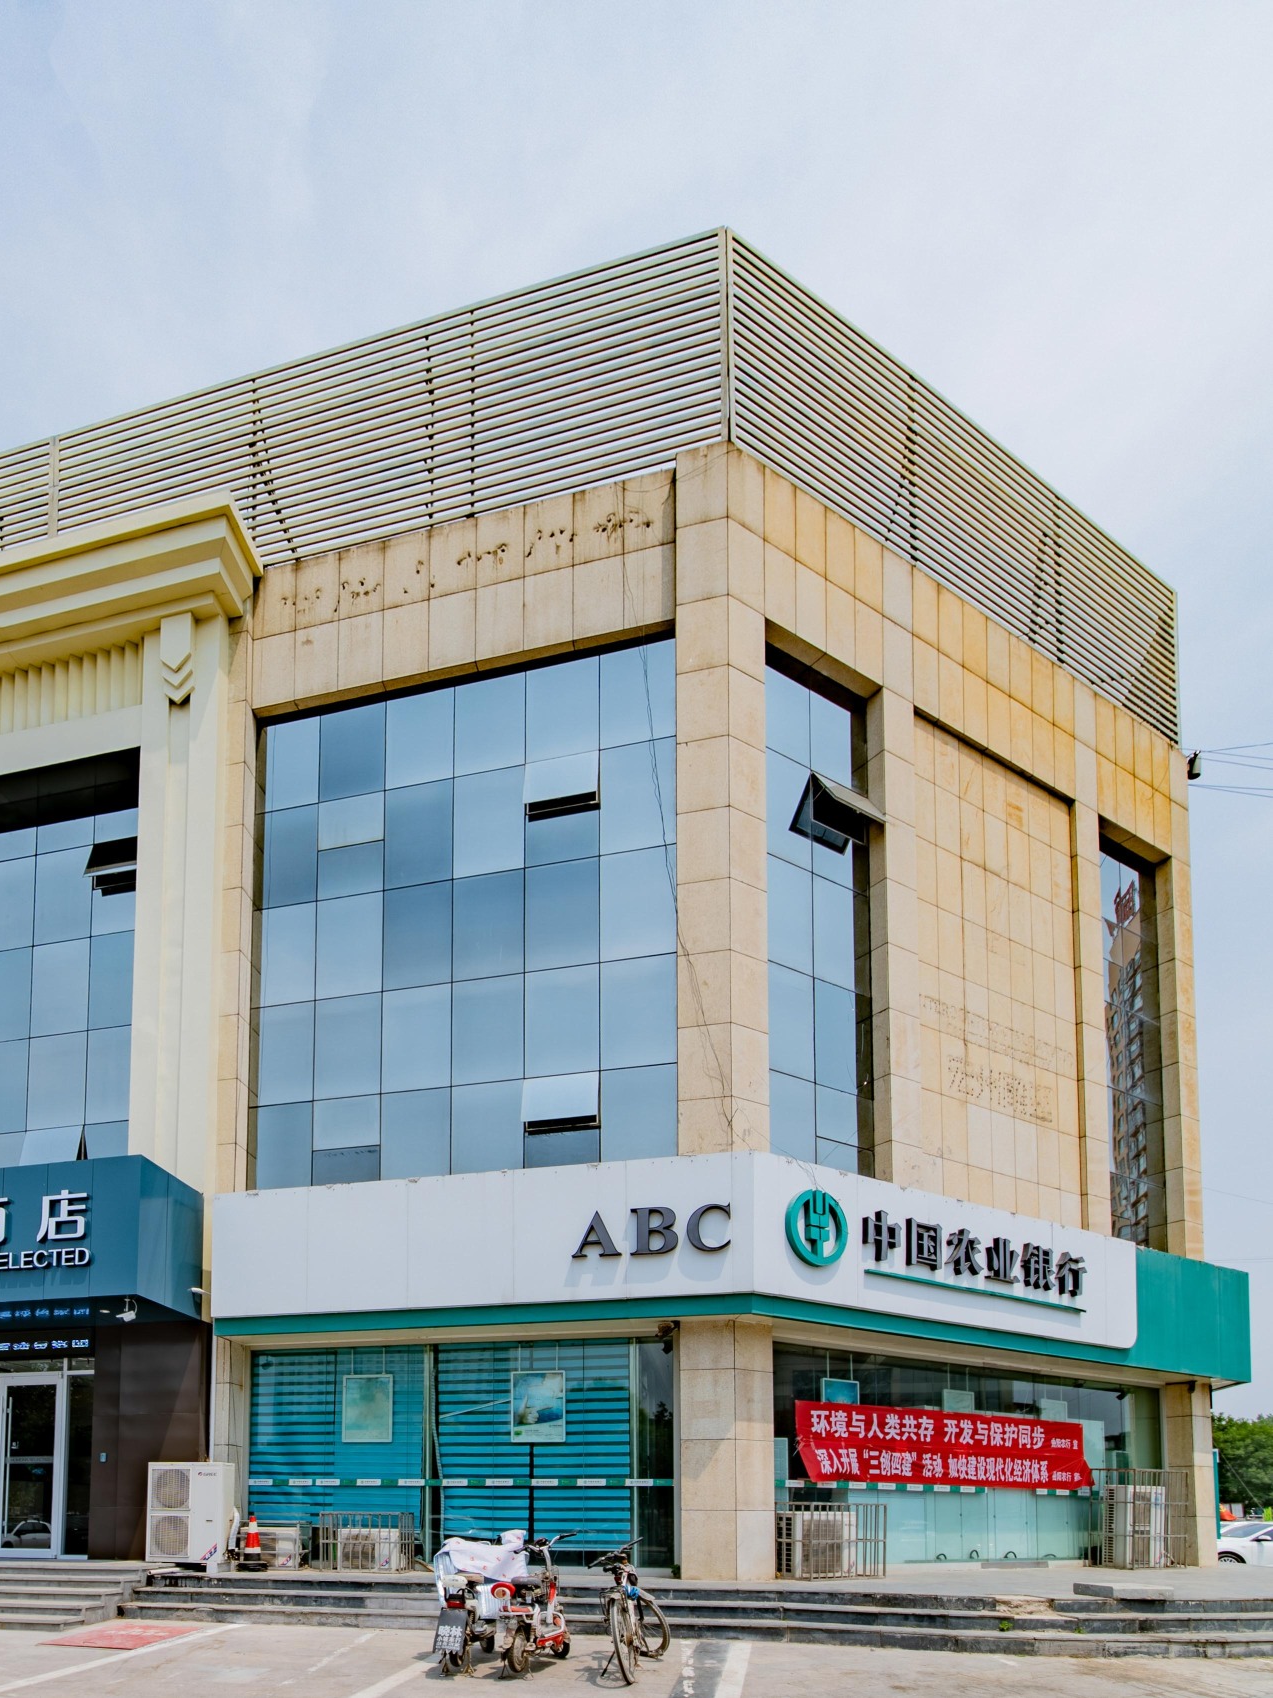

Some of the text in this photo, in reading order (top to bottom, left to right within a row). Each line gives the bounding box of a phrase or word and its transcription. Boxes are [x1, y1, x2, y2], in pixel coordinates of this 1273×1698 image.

[571, 1202, 731, 1258] ABC
[862, 1210, 1087, 1297] 中国农业银行
[810, 1410, 935, 1442] 环境与人类共存
[943, 1419, 1046, 1449] 开发与保护同步
